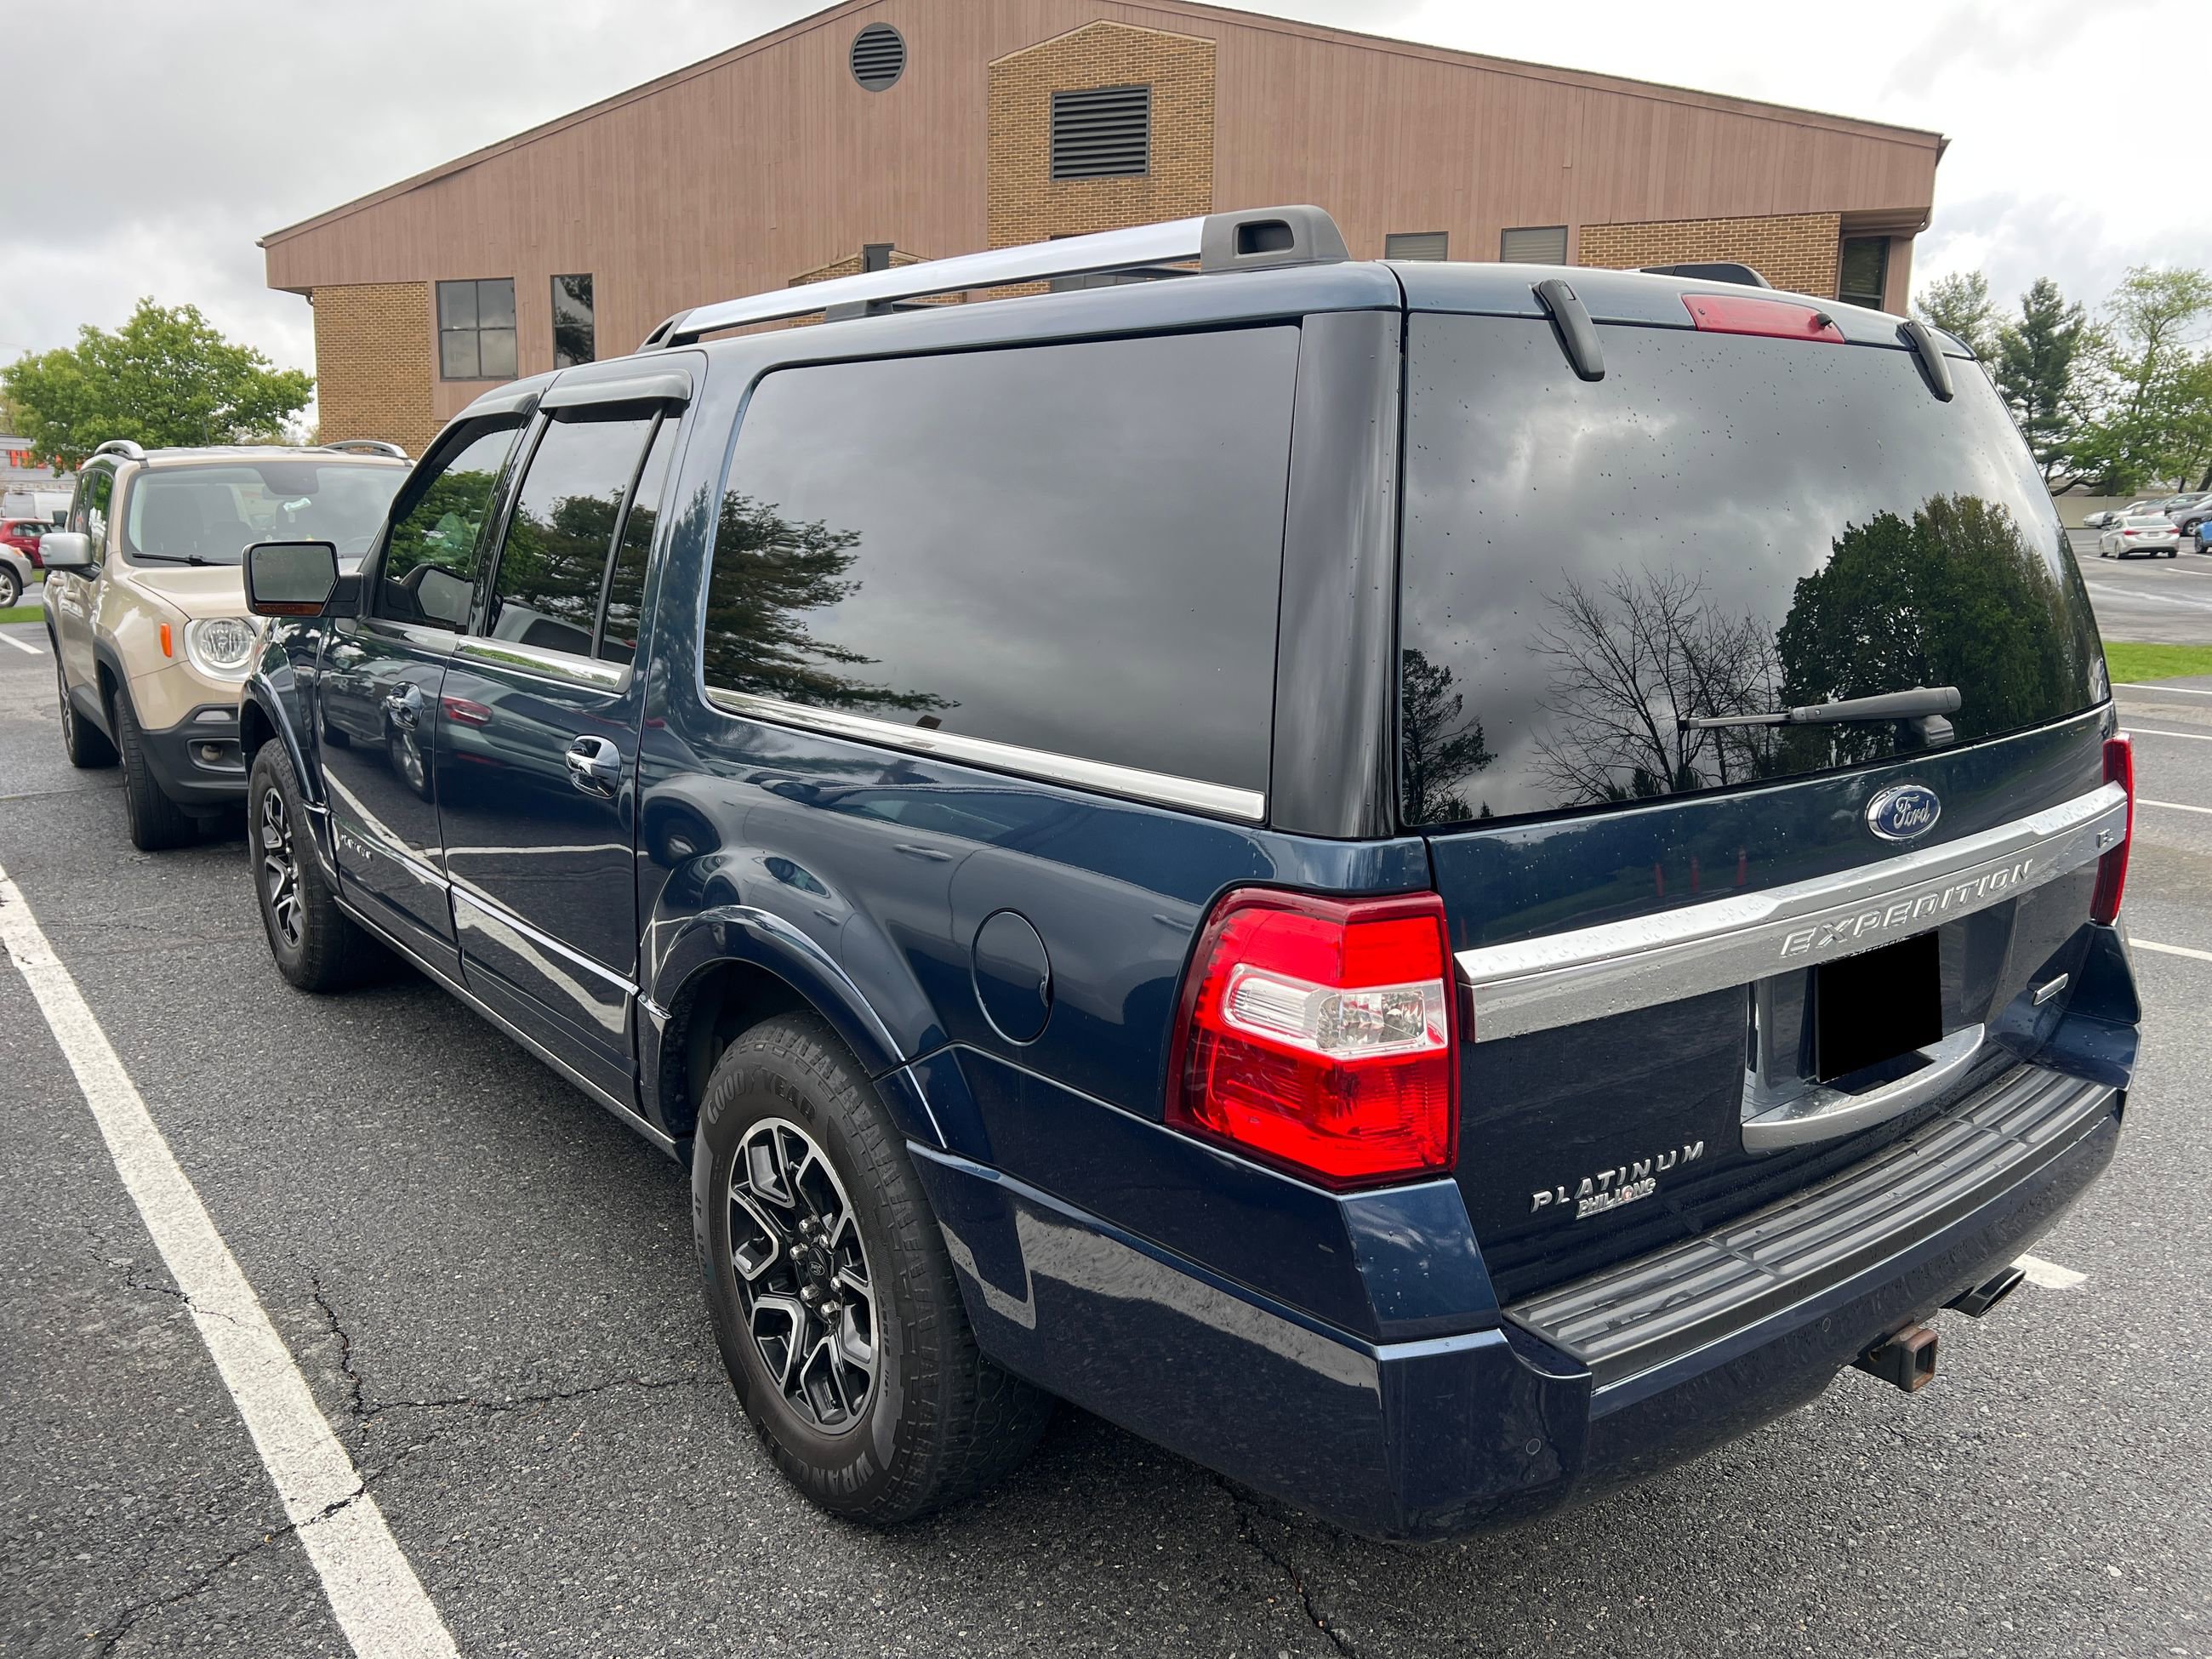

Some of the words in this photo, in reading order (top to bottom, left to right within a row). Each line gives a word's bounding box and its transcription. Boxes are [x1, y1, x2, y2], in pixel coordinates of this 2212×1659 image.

[1893, 795, 1930, 830] Ford
[1780, 858, 2034, 958] EXPEDITION
[1529, 1140, 1704, 1213] PLATINUM
